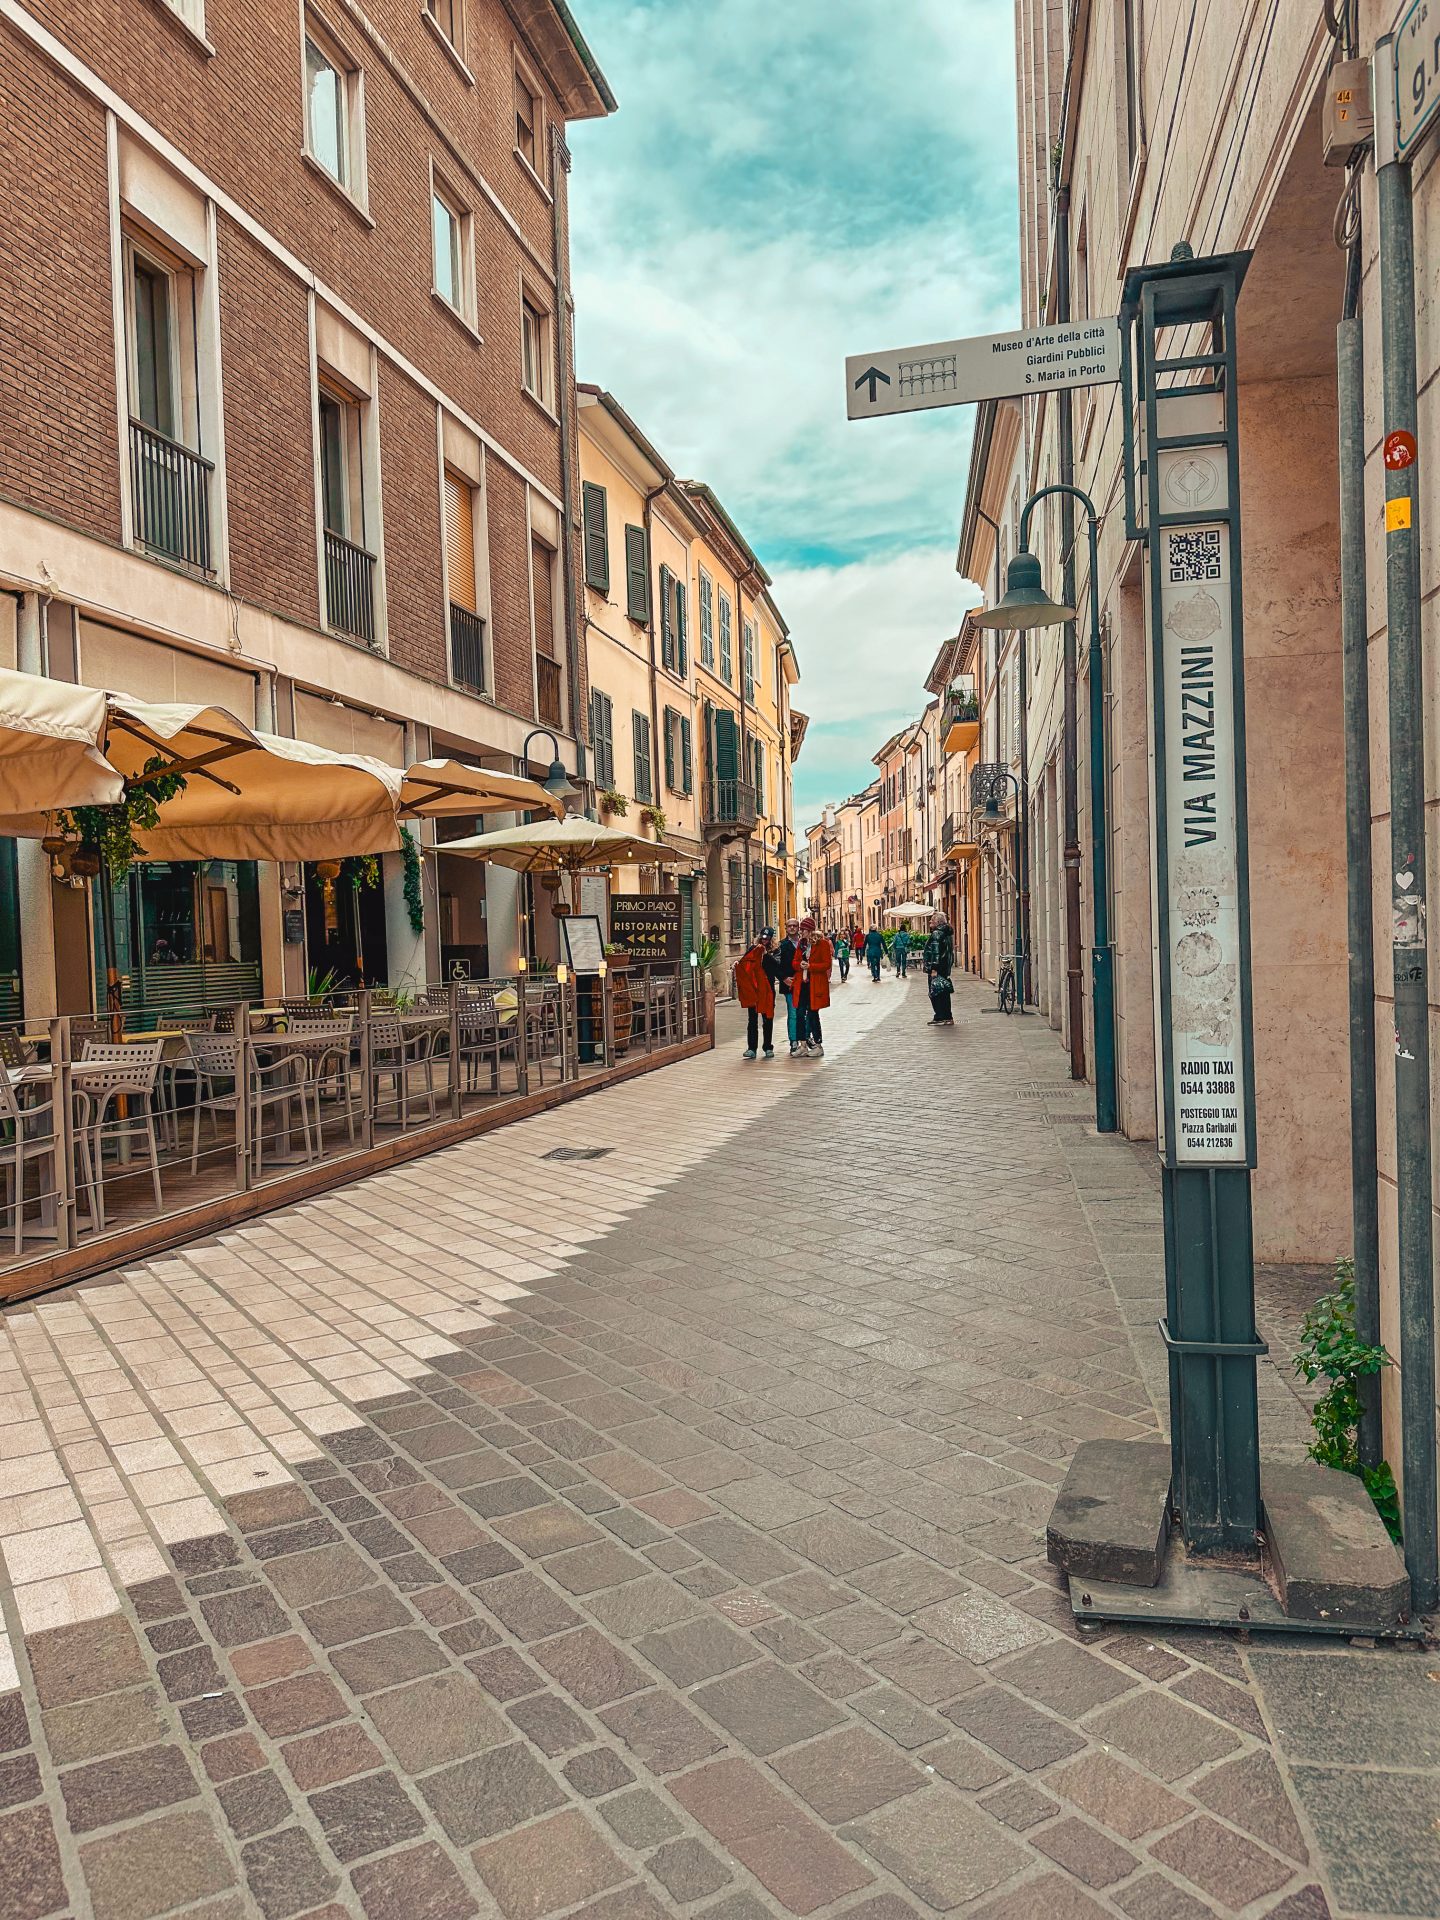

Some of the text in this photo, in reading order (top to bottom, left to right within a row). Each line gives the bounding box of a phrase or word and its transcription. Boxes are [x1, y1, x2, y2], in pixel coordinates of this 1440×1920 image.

[1341, 110, 1347, 119] 7
[992, 327, 1105, 353] Museo d'Arte della città
[1026, 345, 1105, 366] Giardini Pubblici
[1025, 364, 1106, 384] S. Maria in Porto
[1181, 646, 1216, 781] MAZZINI
[1184, 792, 1217, 848] VIA
[616, 901, 676, 911] PRIMO PIANO
[614, 922, 678, 931] RISTORANTE
[627, 948, 667, 957] PIZZERIA
[1181, 1061, 1233, 1075] RADIO TAXI
[1180, 1081, 1235, 1095] 0544 33888
[1180, 1108, 1238, 1119] POSTEGGIO TAXI
[1182, 1122, 1237, 1133] Piazza Garibaldi
[1187, 1137, 1233, 1148] 0544 212636
